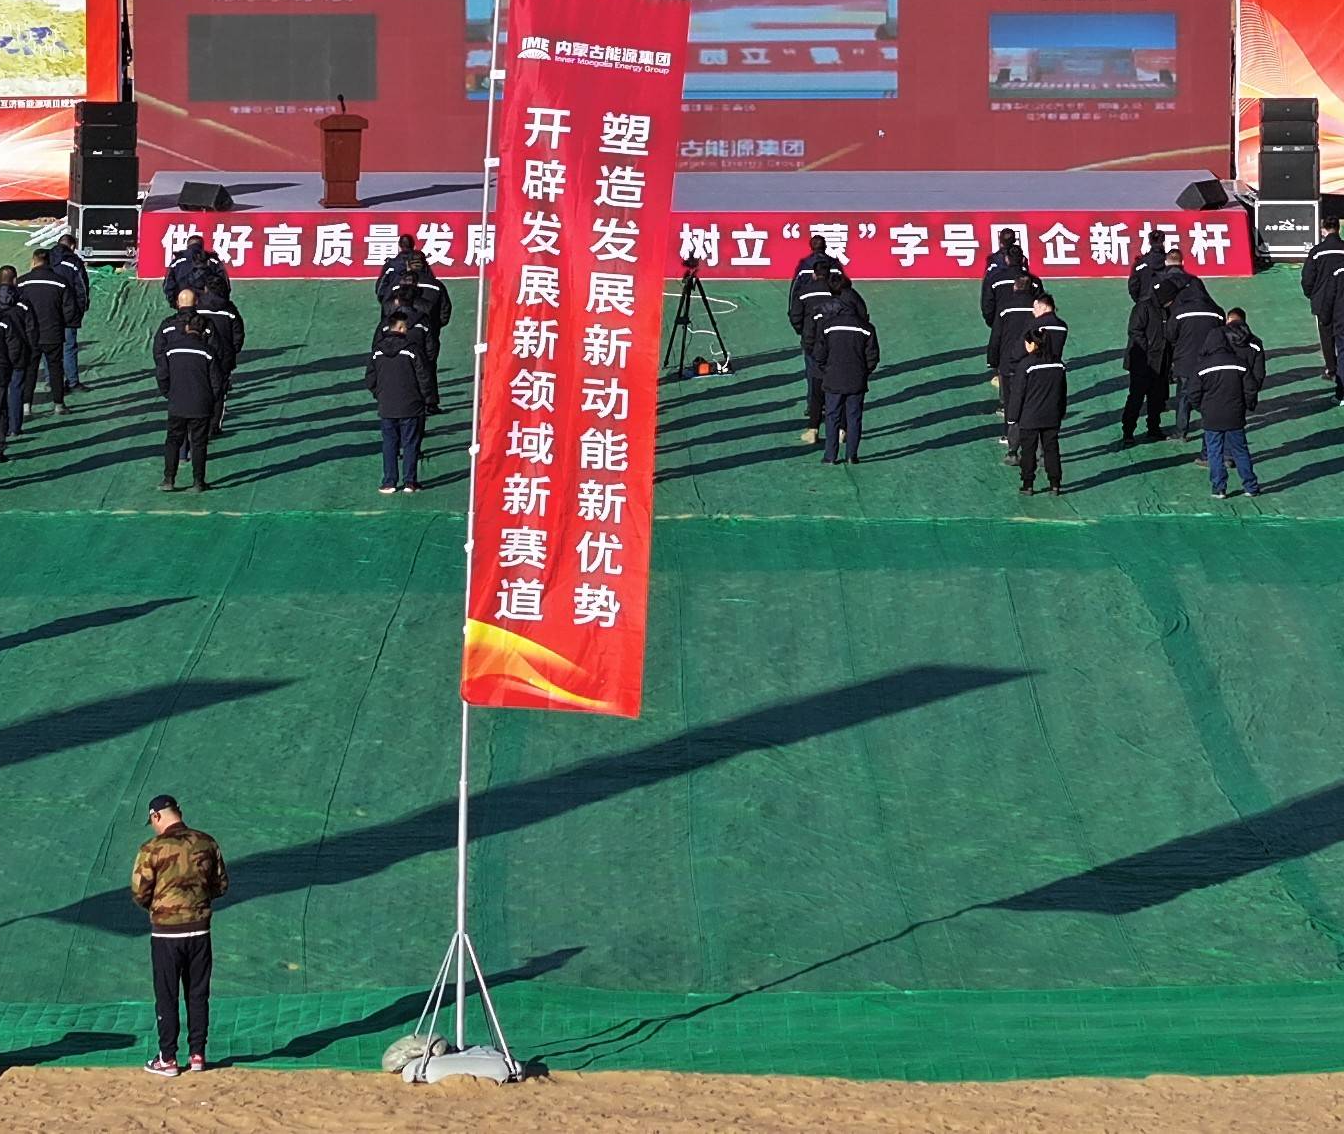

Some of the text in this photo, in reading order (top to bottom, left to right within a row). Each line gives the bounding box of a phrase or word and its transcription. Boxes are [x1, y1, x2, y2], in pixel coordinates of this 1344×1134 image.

[521, 36, 551, 53] IME
[555, 40, 672, 67] 内蒙古能源集团
[494, 107, 572, 622] 开辟发展新领域新赛道
[573, 111, 651, 628] 塑造发展新动能新优势
